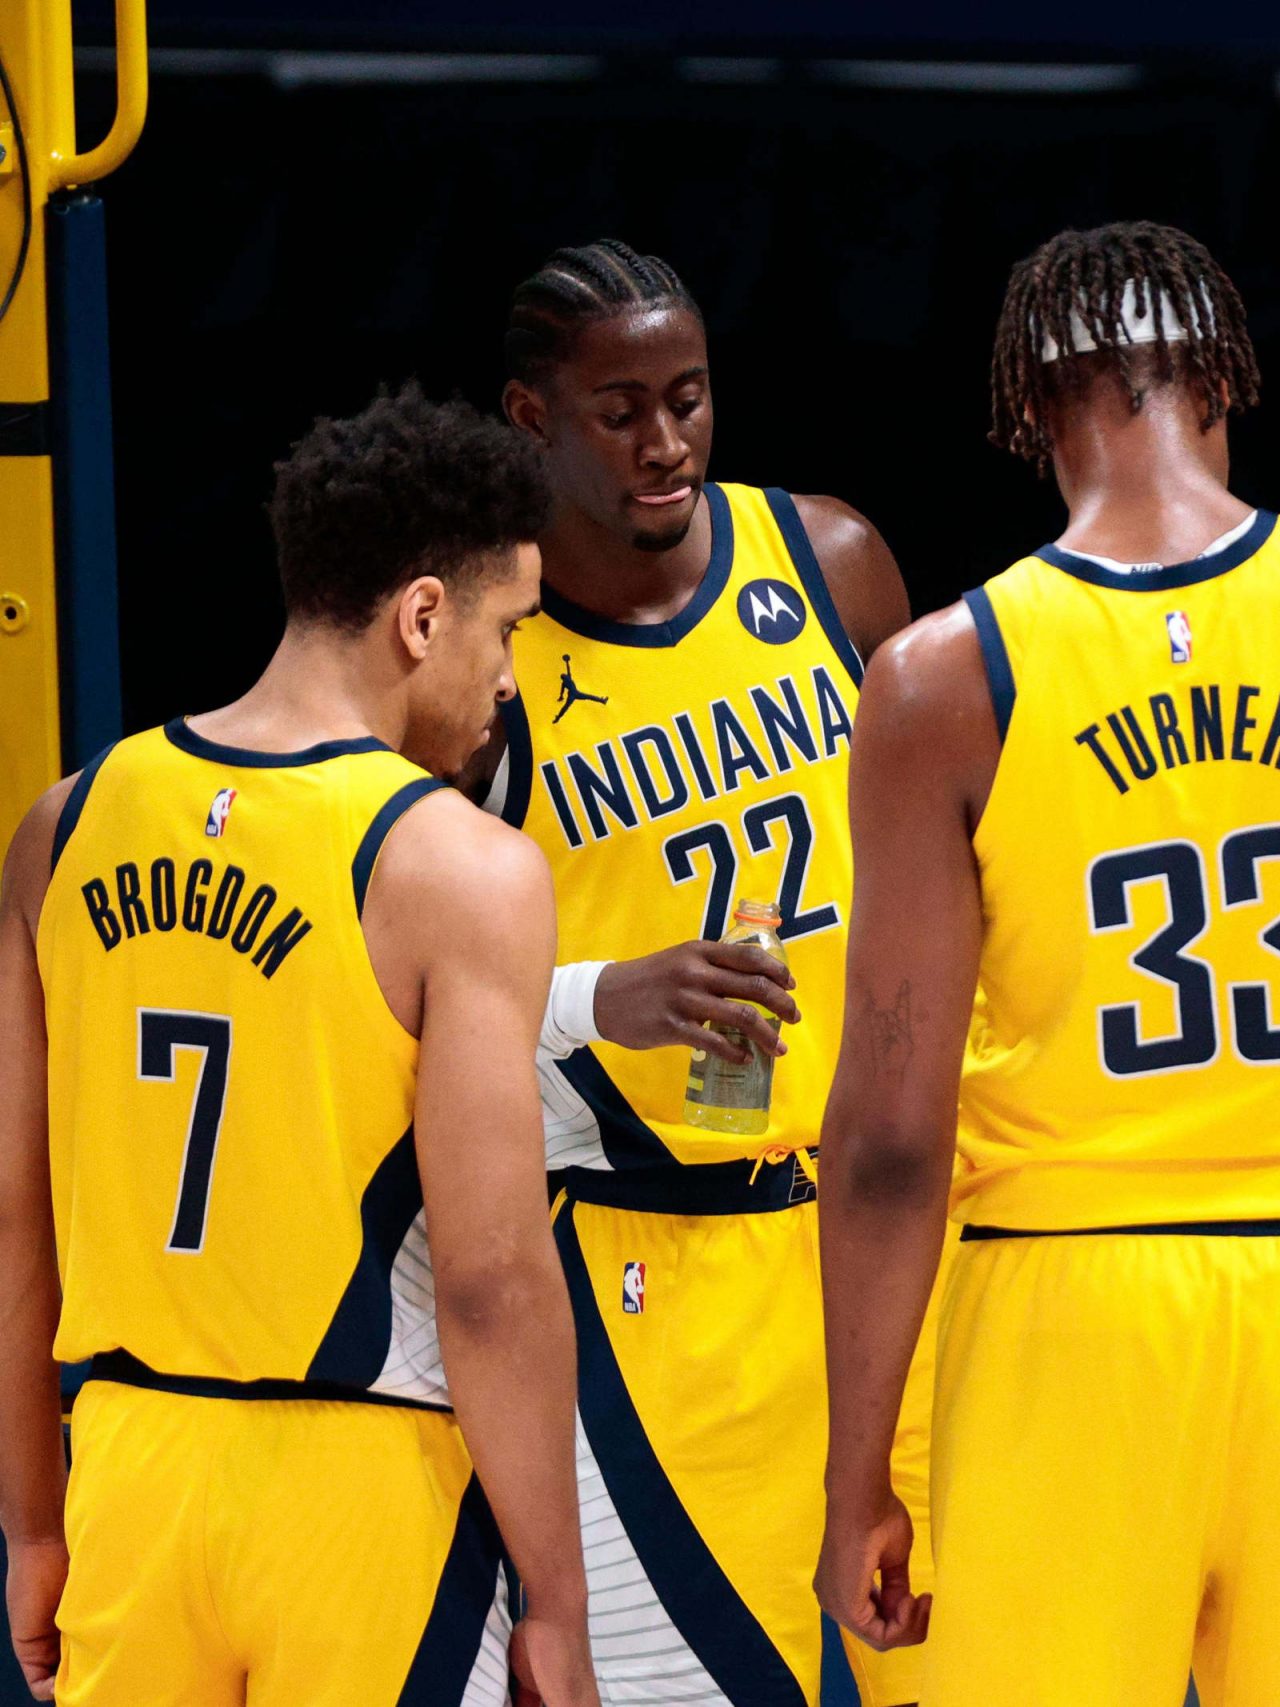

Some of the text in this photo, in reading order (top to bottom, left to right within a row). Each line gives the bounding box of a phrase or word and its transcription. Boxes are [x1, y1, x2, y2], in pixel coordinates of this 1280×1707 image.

[539, 664, 855, 850] INDIANA
[81, 856, 313, 980] BROGDON
[661, 791, 842, 944] 22
[136, 1006, 232, 1256] 7
